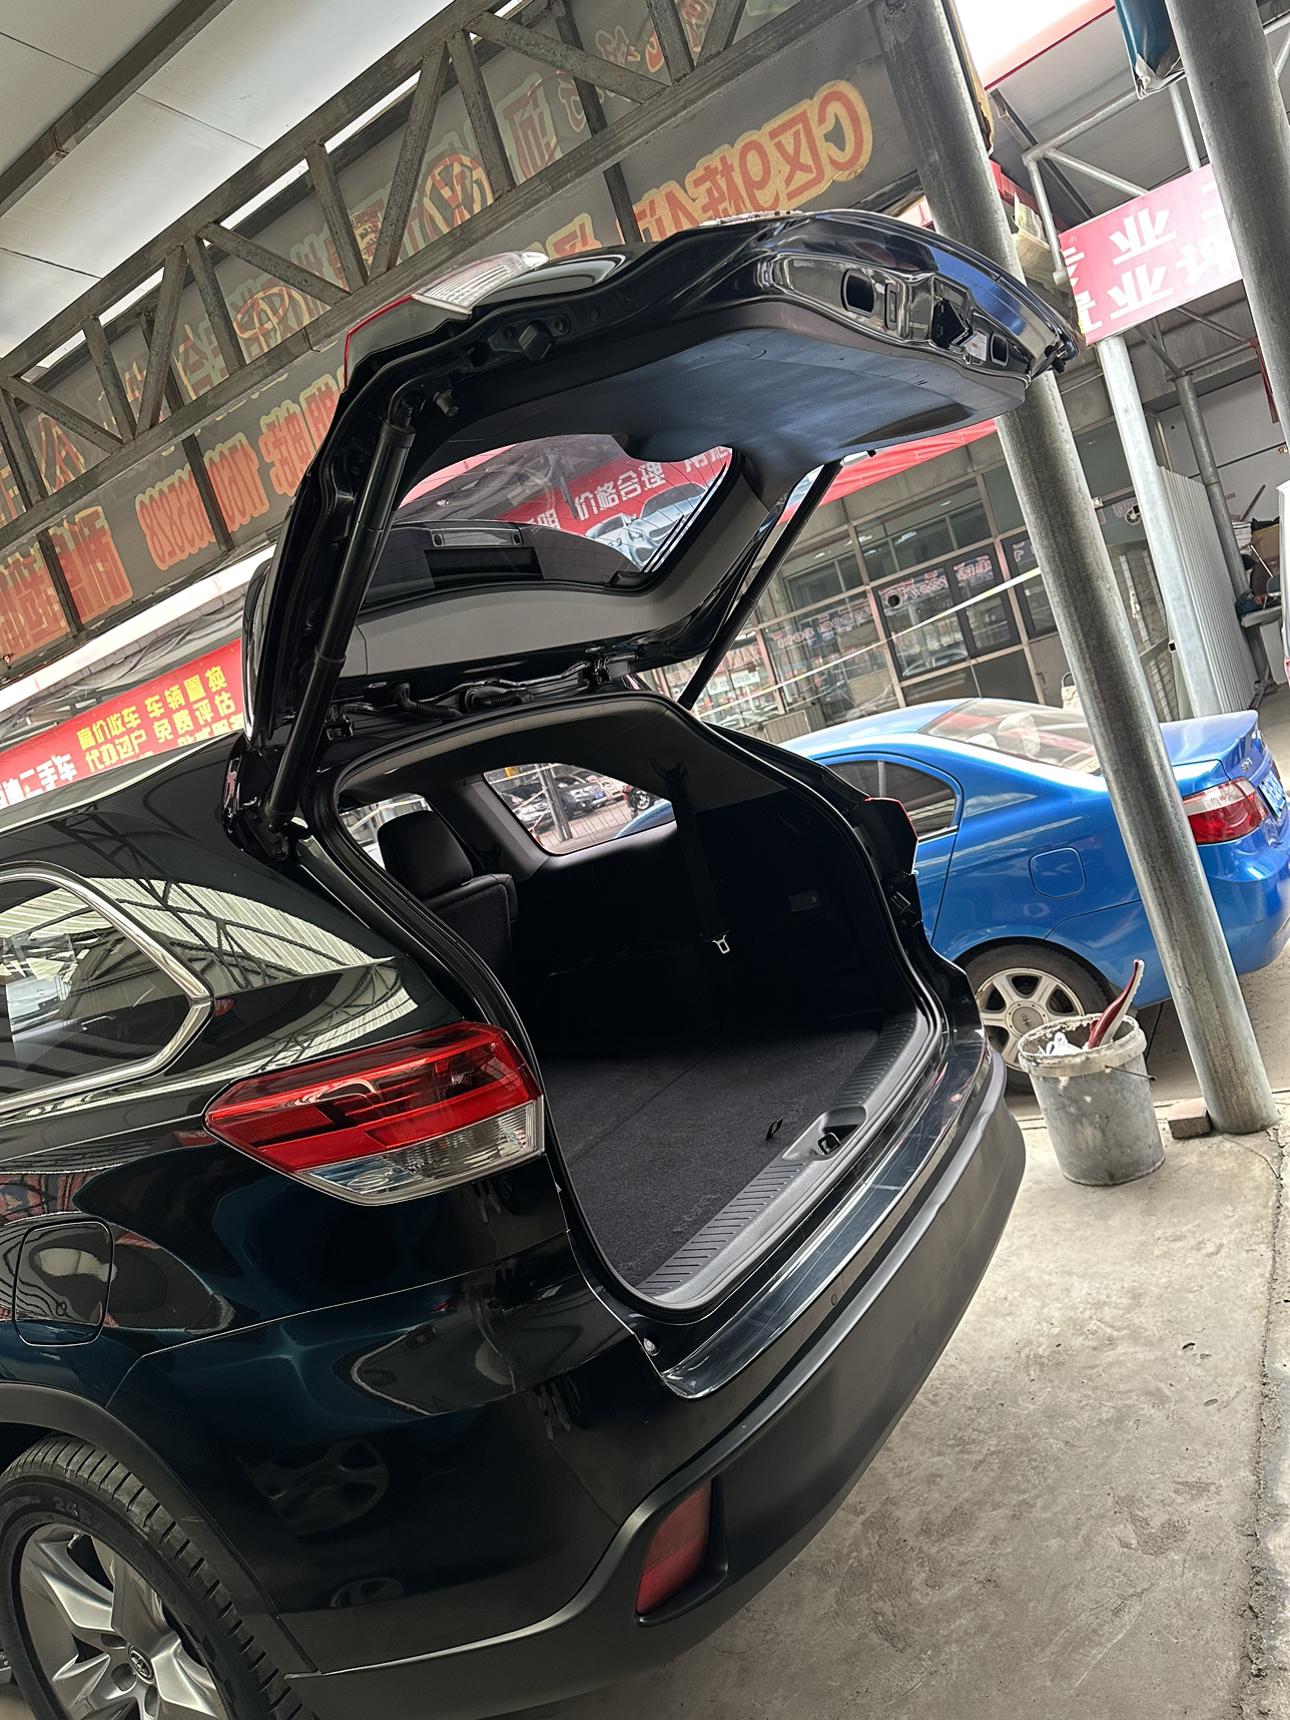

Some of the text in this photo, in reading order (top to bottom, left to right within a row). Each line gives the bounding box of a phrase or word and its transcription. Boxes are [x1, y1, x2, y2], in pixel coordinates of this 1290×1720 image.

[574, 461, 666, 521] 价格合理
[76, 705, 141, 751] 高价收车
[153, 691, 236, 744] 免费评估
